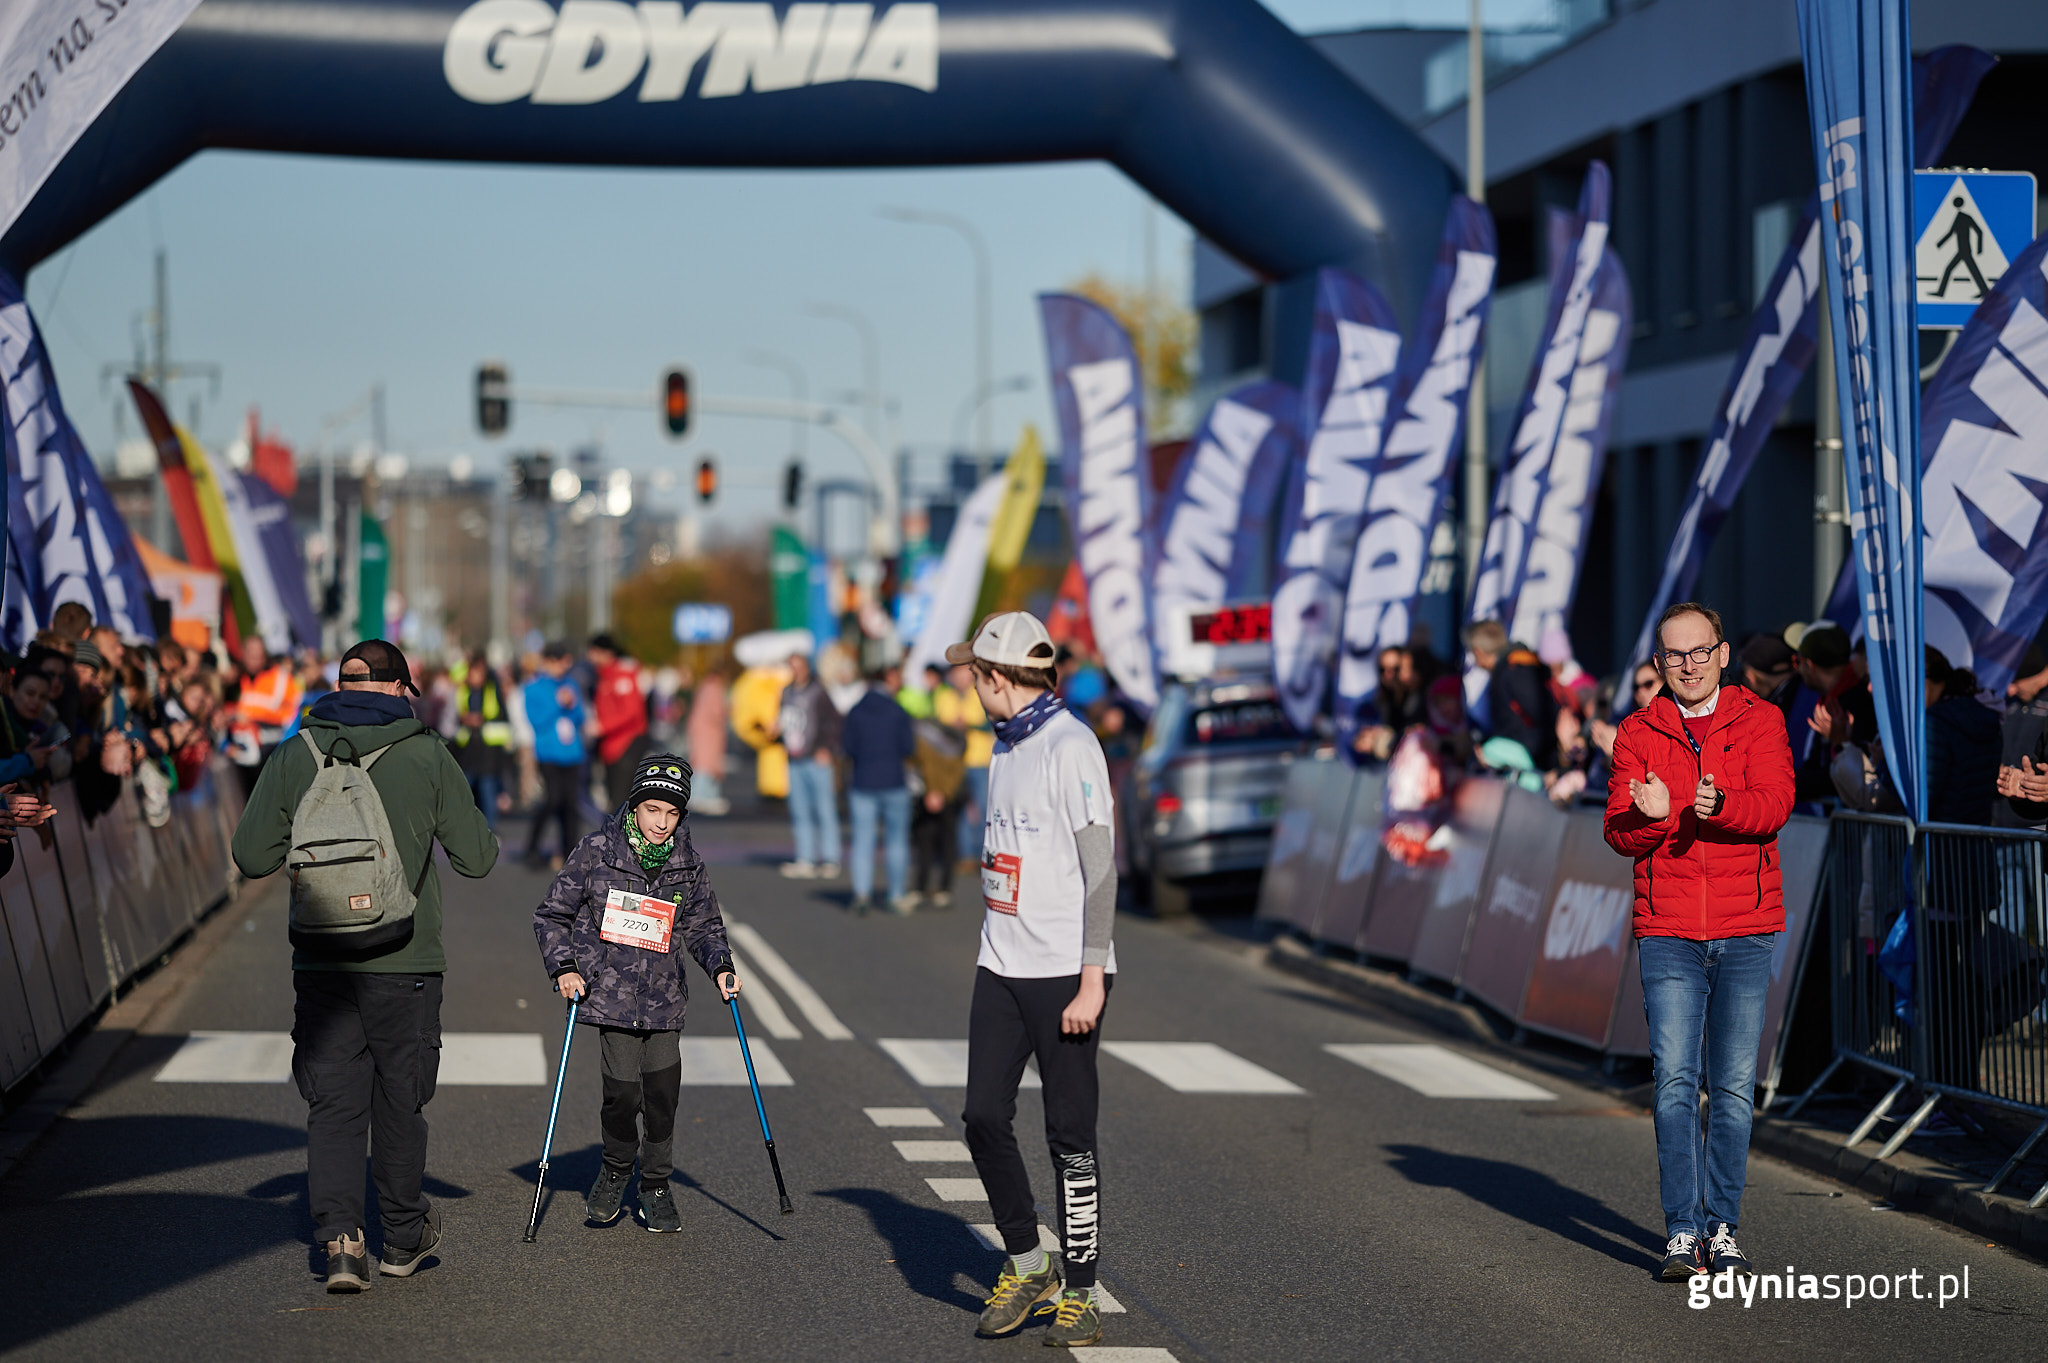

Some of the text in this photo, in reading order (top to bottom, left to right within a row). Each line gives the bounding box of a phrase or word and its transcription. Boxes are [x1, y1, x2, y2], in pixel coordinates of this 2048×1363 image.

[48, 16, 95, 73] na
[443, 0, 939, 104] GDYNIA
[622, 918, 649, 932] 7270
[1063, 1176, 1098, 1263] LIMITS
